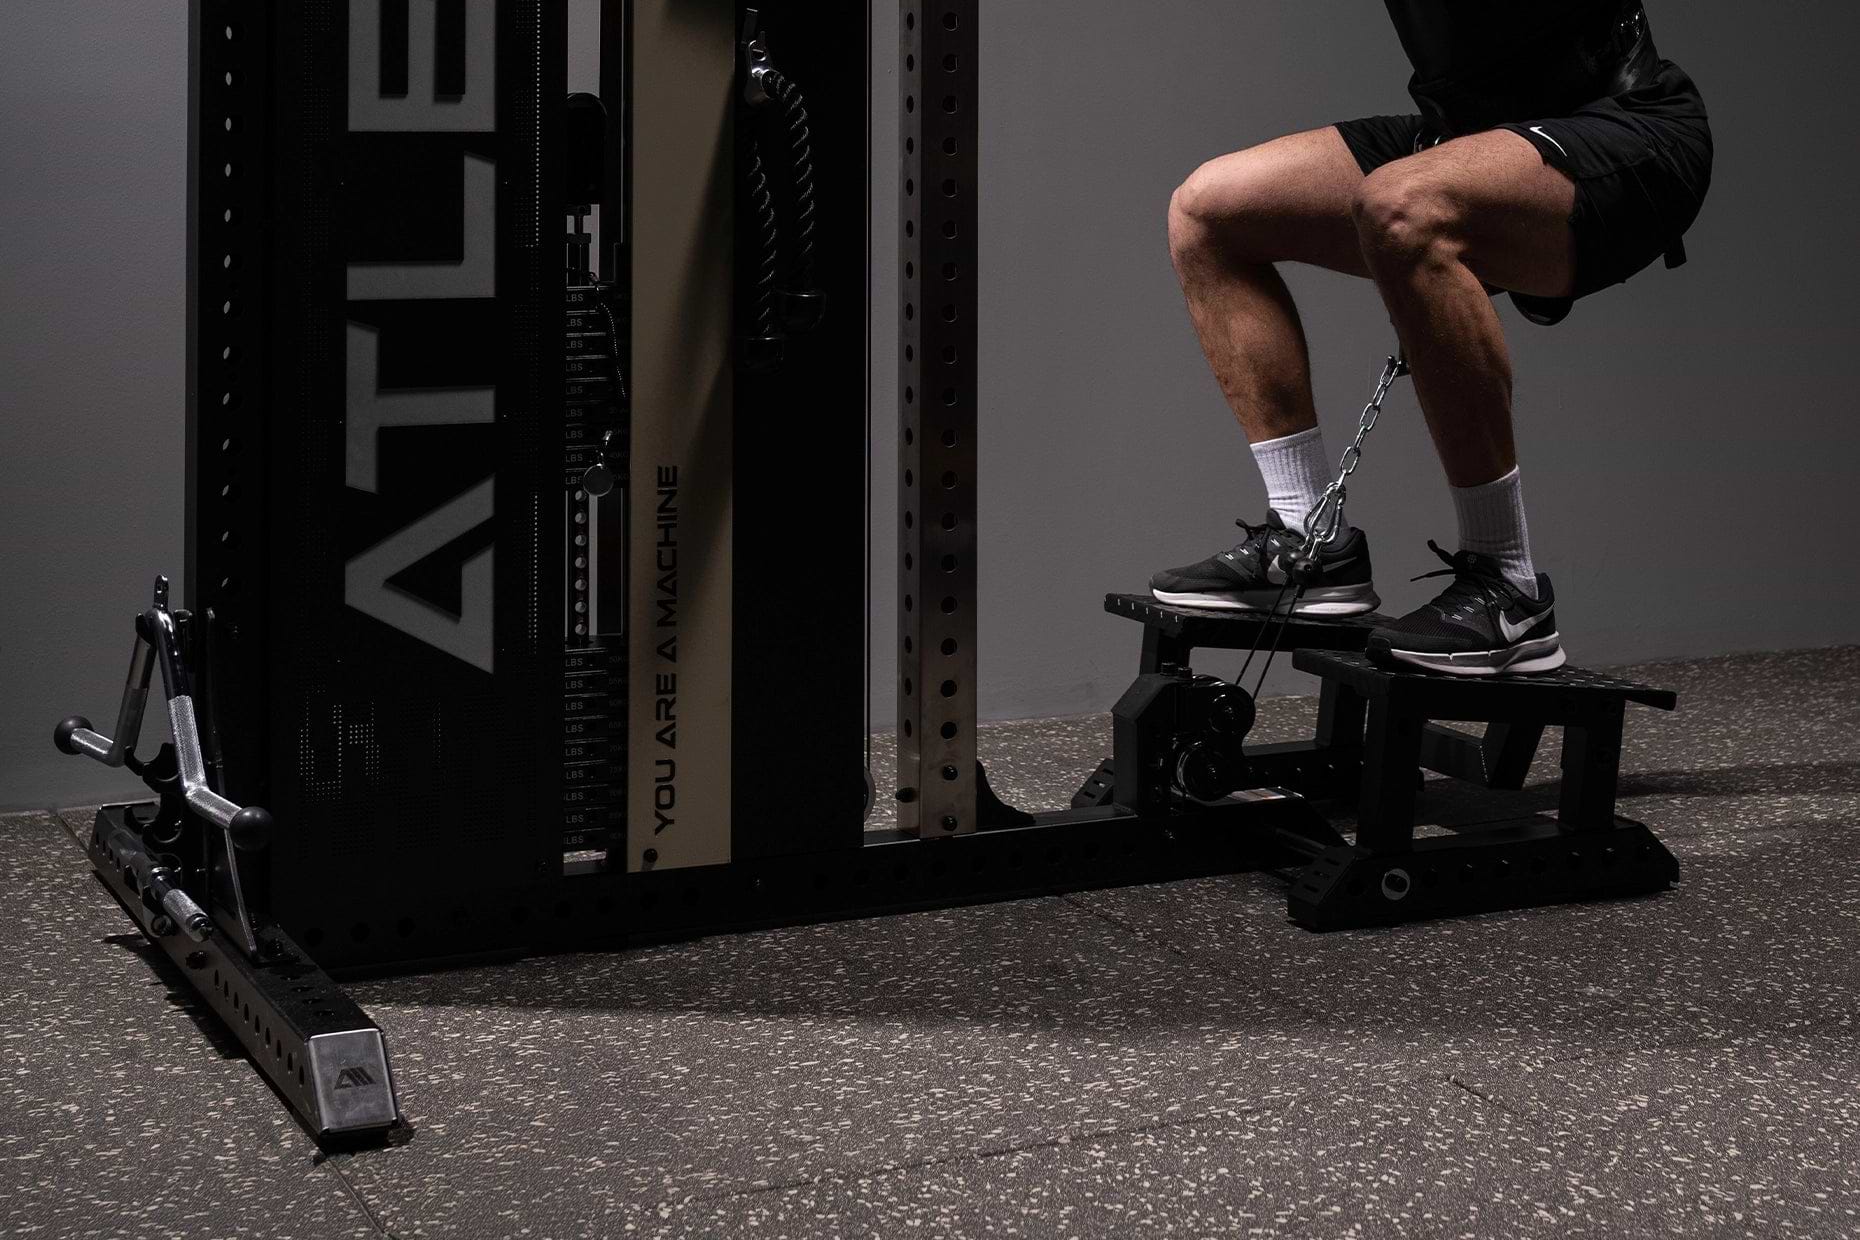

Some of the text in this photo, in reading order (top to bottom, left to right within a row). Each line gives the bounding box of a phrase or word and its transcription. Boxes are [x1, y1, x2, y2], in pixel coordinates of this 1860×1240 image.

[654, 465, 679, 836] YOU ARE A MACHINE
